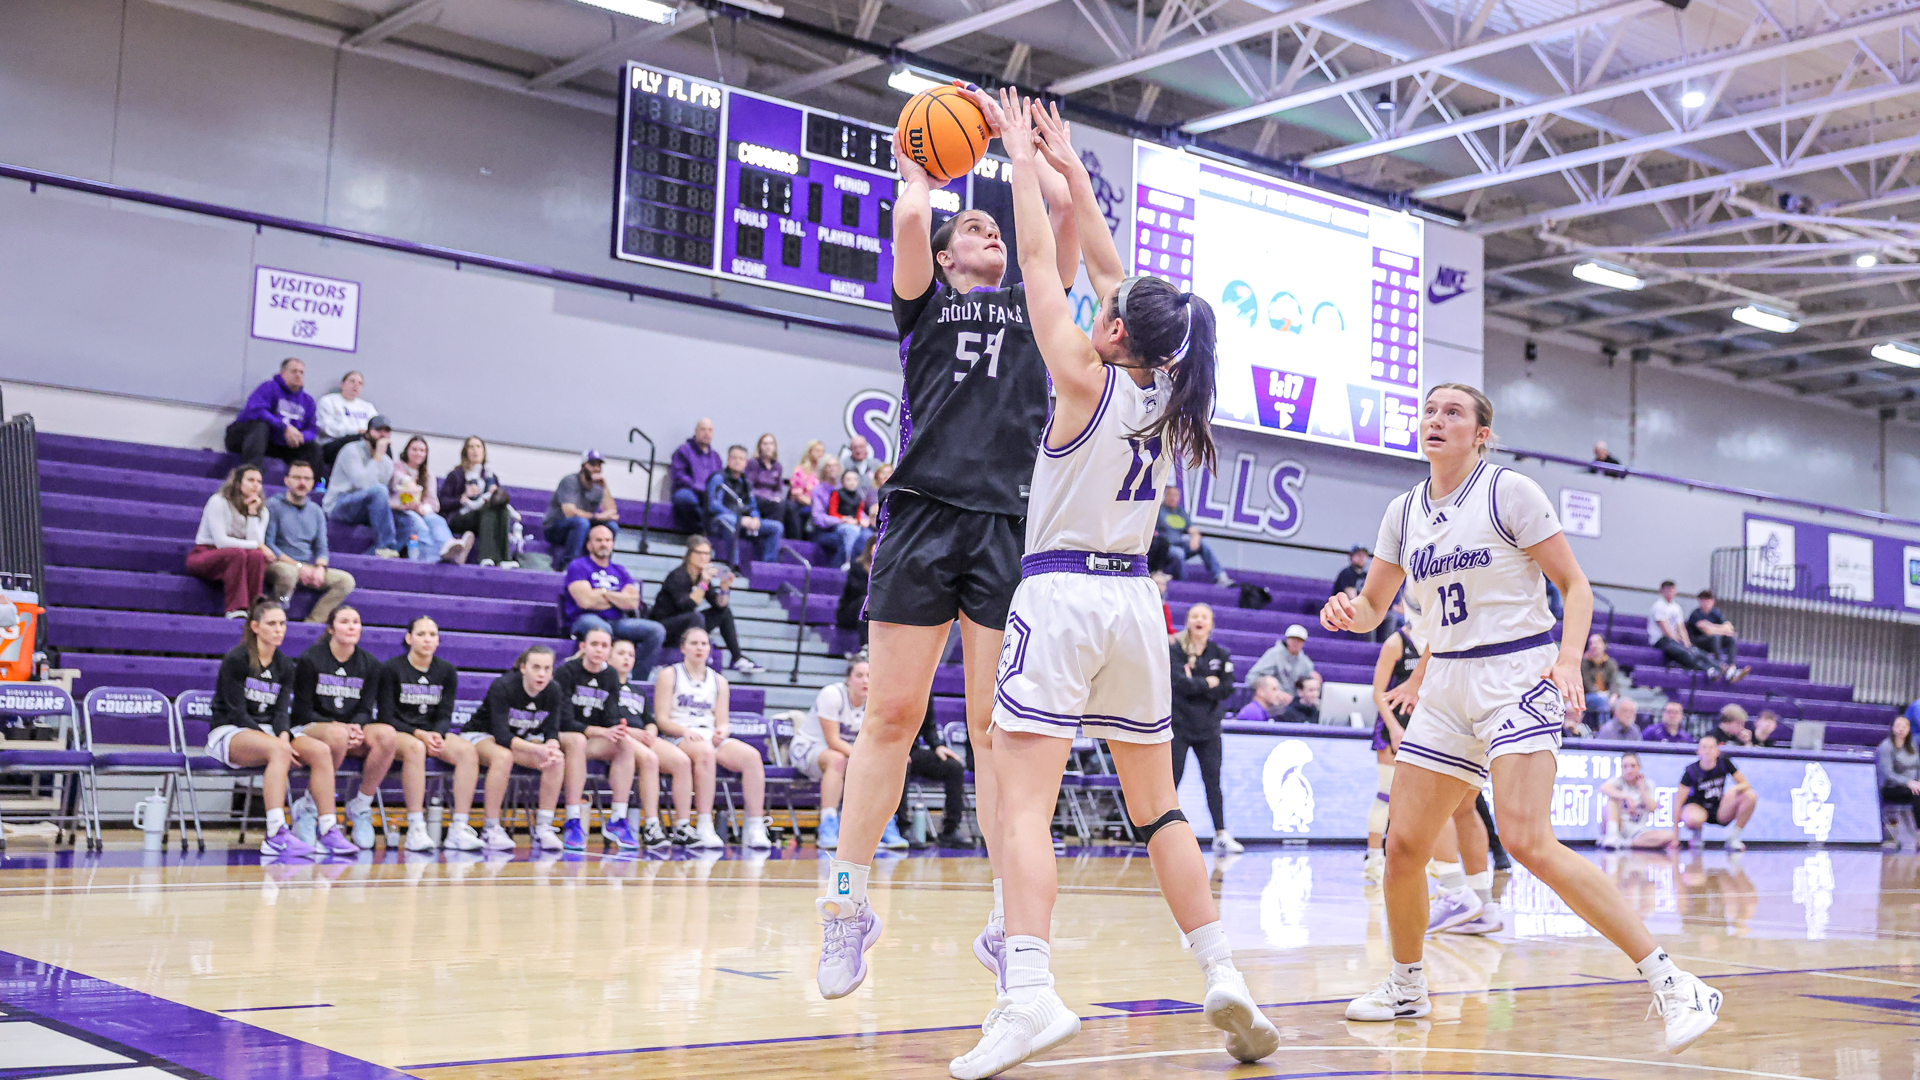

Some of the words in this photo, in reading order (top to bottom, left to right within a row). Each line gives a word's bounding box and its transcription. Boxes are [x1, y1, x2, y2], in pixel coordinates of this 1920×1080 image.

[632, 67, 662, 94] PLY
[667, 76, 688, 102] FL
[690, 82, 721, 109] PTS
[833, 173, 871, 196] PERIOD
[733, 208, 768, 229] FOULS
[817, 226, 855, 248] PLAYER
[856, 234, 882, 254] FOUL
[731, 258, 767, 280] SCORE
[270, 275, 347, 300] VISITORS
[830, 279, 865, 299] MATCH
[269, 294, 344, 317] SECTION
[953, 327, 1005, 382] 54
[1268, 371, 1304, 400] 1:17
[1409, 543, 1492, 583] Warriors
[1437, 582, 1469, 627] 13
[0, 696, 65, 710] COUGARS
[96, 699, 163, 714] COUGARS
